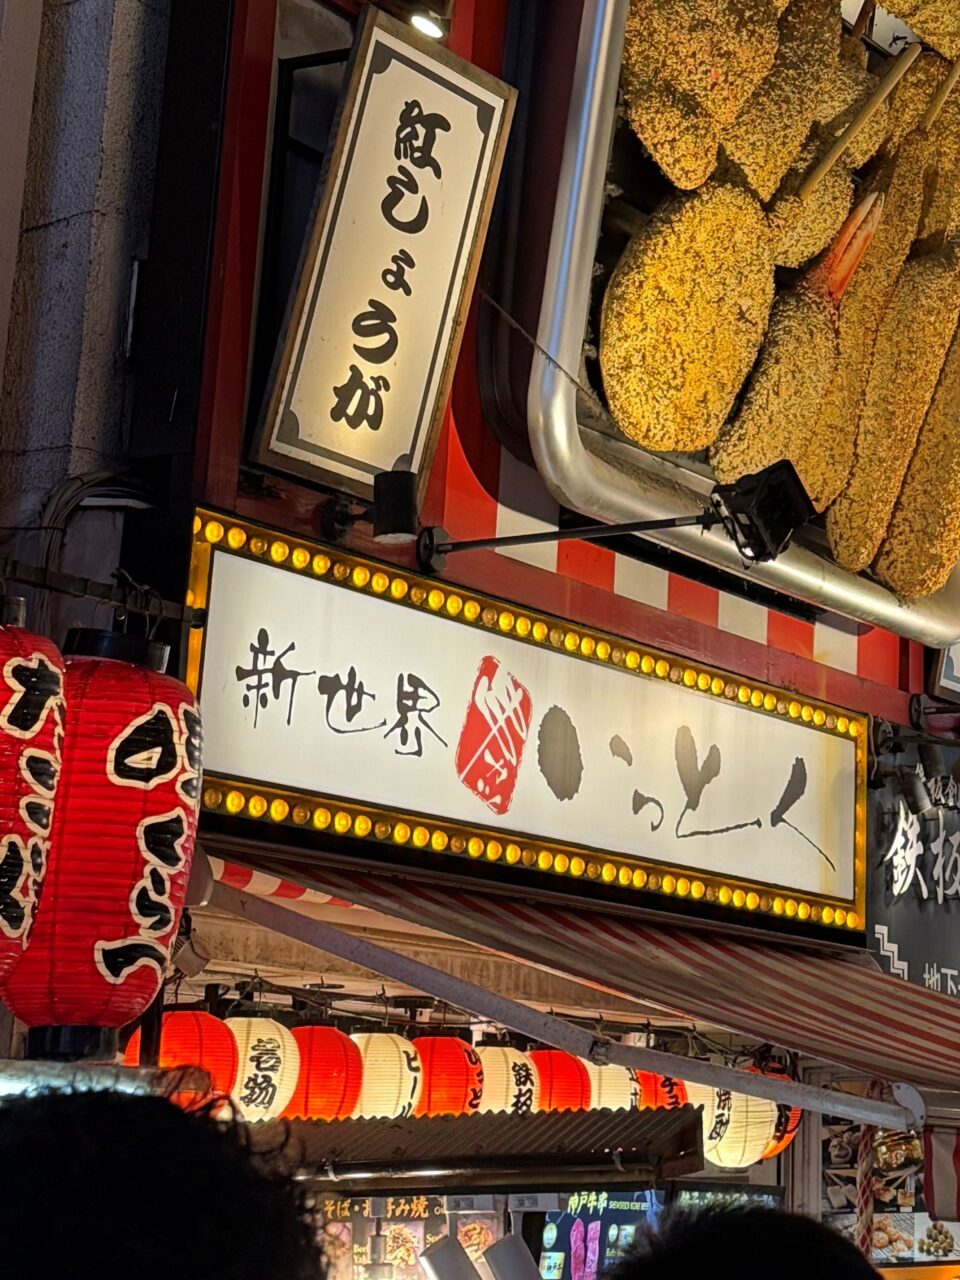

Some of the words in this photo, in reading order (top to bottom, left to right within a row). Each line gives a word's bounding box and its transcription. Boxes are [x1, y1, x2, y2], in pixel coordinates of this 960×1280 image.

[330, 99, 452, 432] 紅しょうが
[235, 628, 448, 758] 新世界
[538, 704, 837, 873] いっとく
